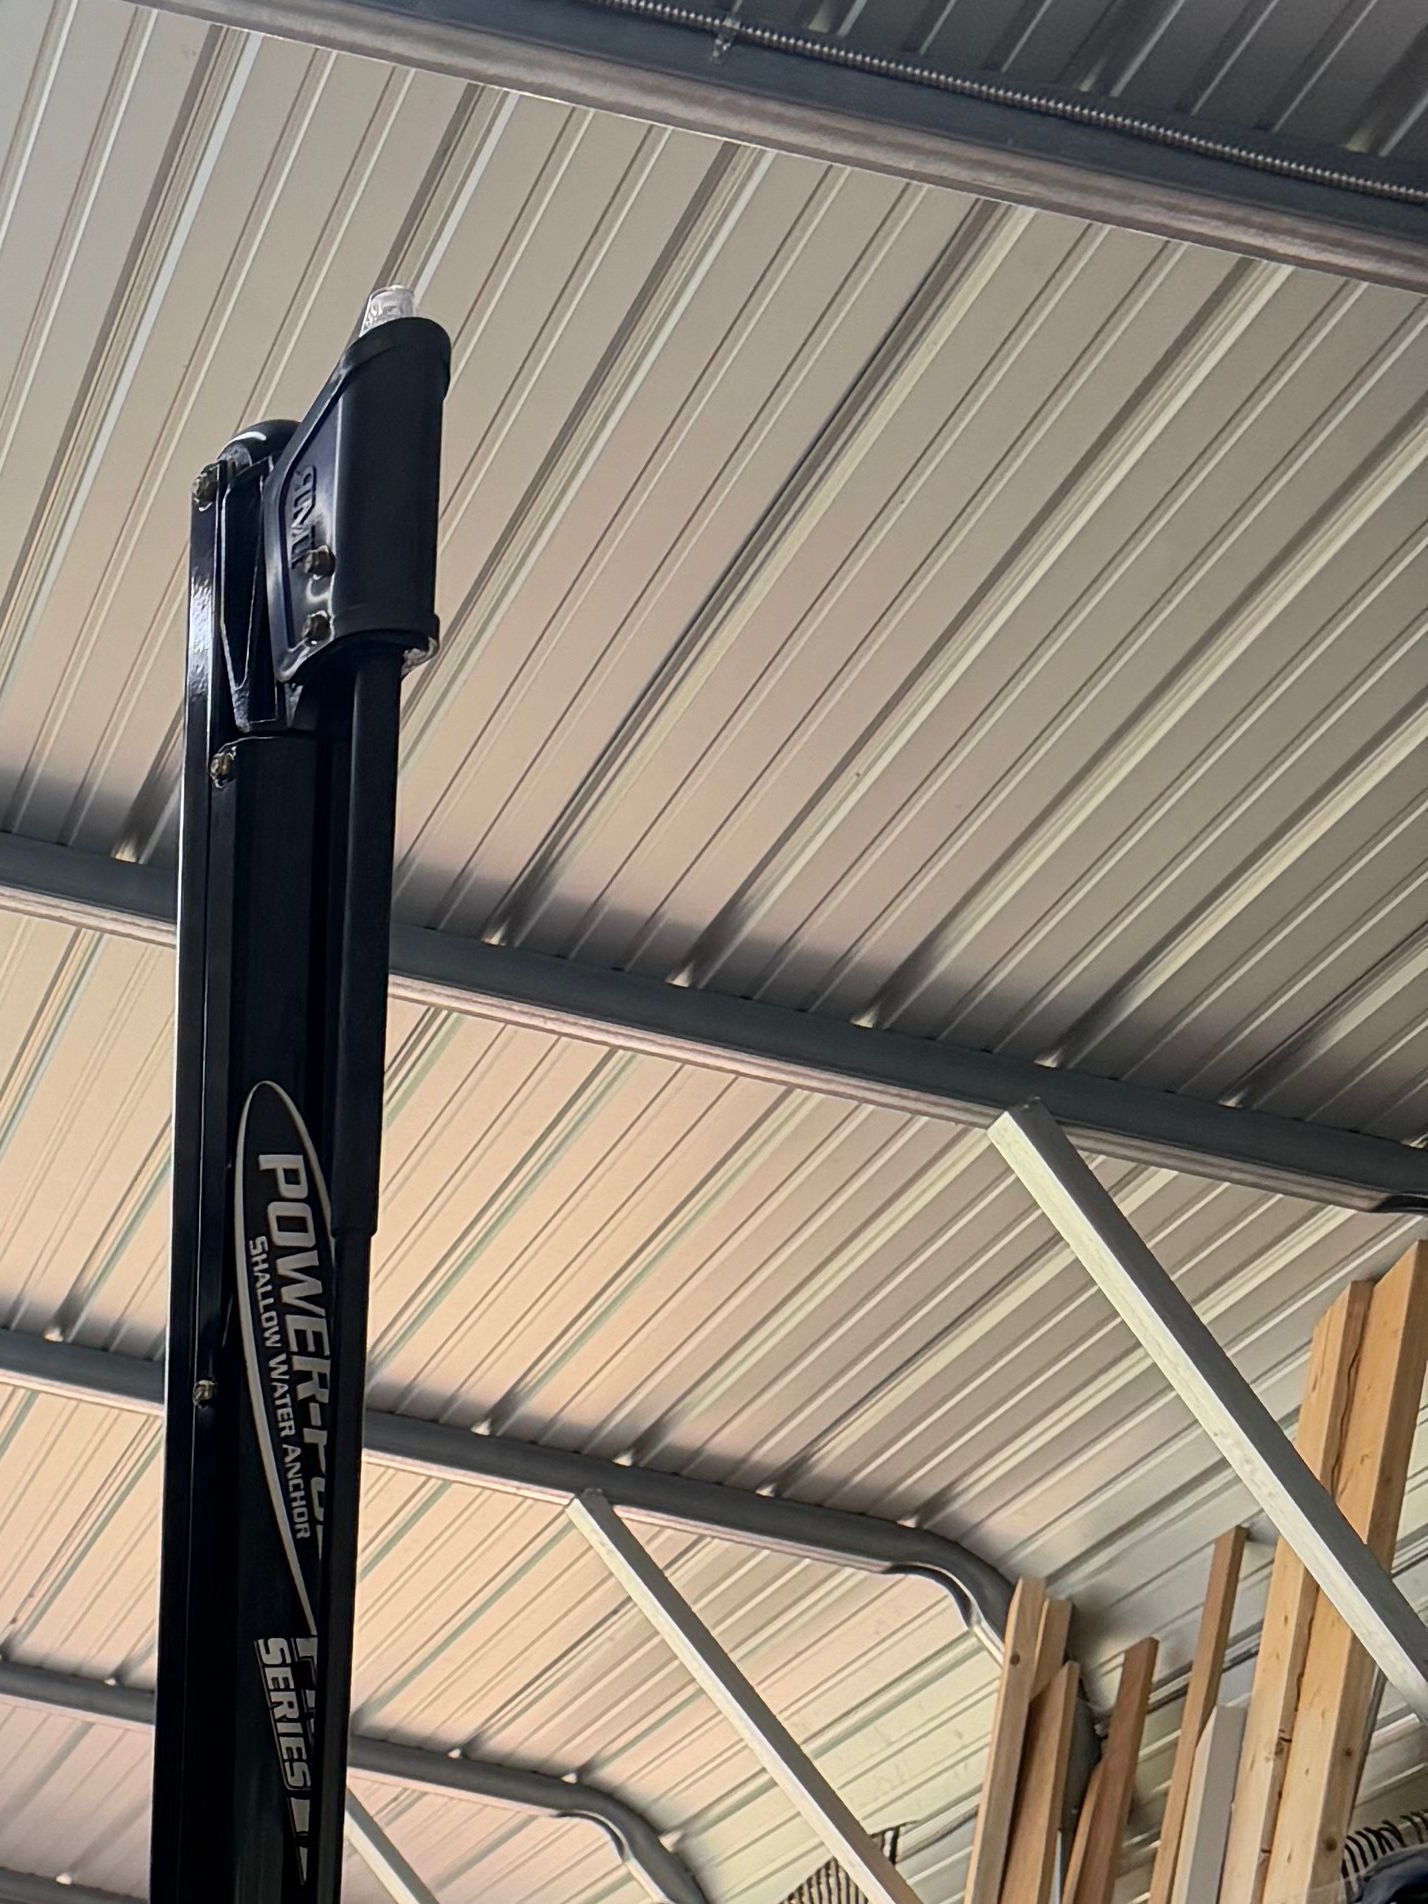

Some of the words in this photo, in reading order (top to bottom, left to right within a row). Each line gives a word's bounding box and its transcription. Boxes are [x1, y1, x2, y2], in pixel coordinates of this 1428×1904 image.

[249, 1234, 284, 1348] SHALLOW
[268, 1352, 296, 1438] WATER
[281, 1443, 311, 1541] ANCHOR
[256, 1637, 313, 1790] SERIES
